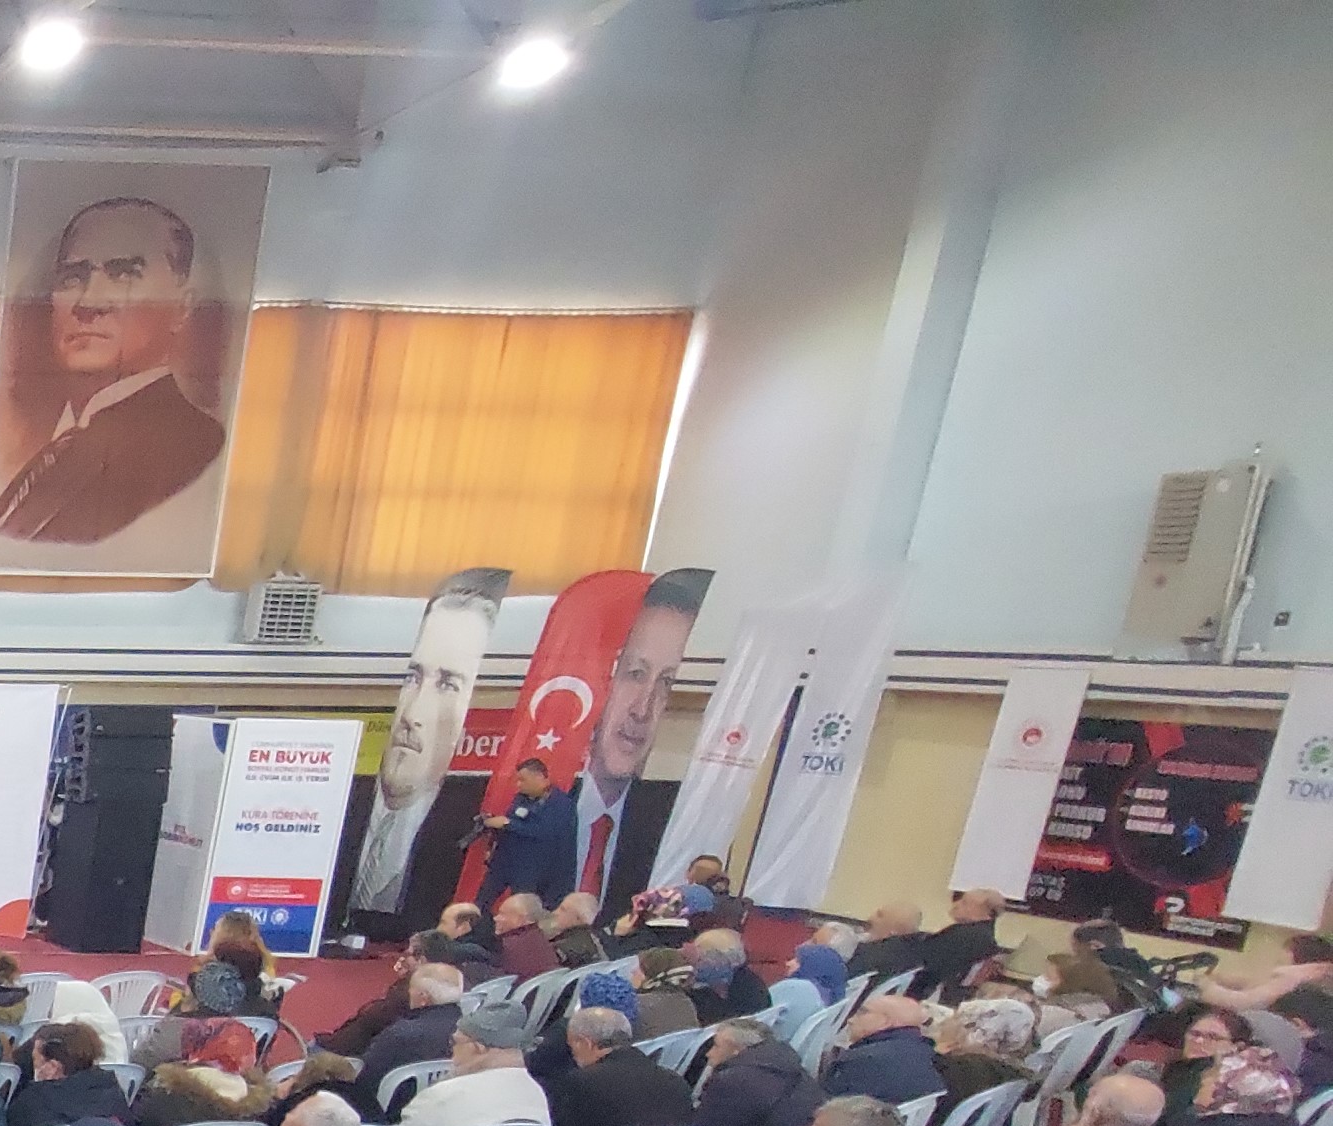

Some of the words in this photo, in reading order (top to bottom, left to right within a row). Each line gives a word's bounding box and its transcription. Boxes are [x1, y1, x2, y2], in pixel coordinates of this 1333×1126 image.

[455, 728, 507, 758] ber
[248, 749, 271, 763] EN
[241, 810, 268, 819] KURA
[264, 823, 321, 834] GELDİNİZ
